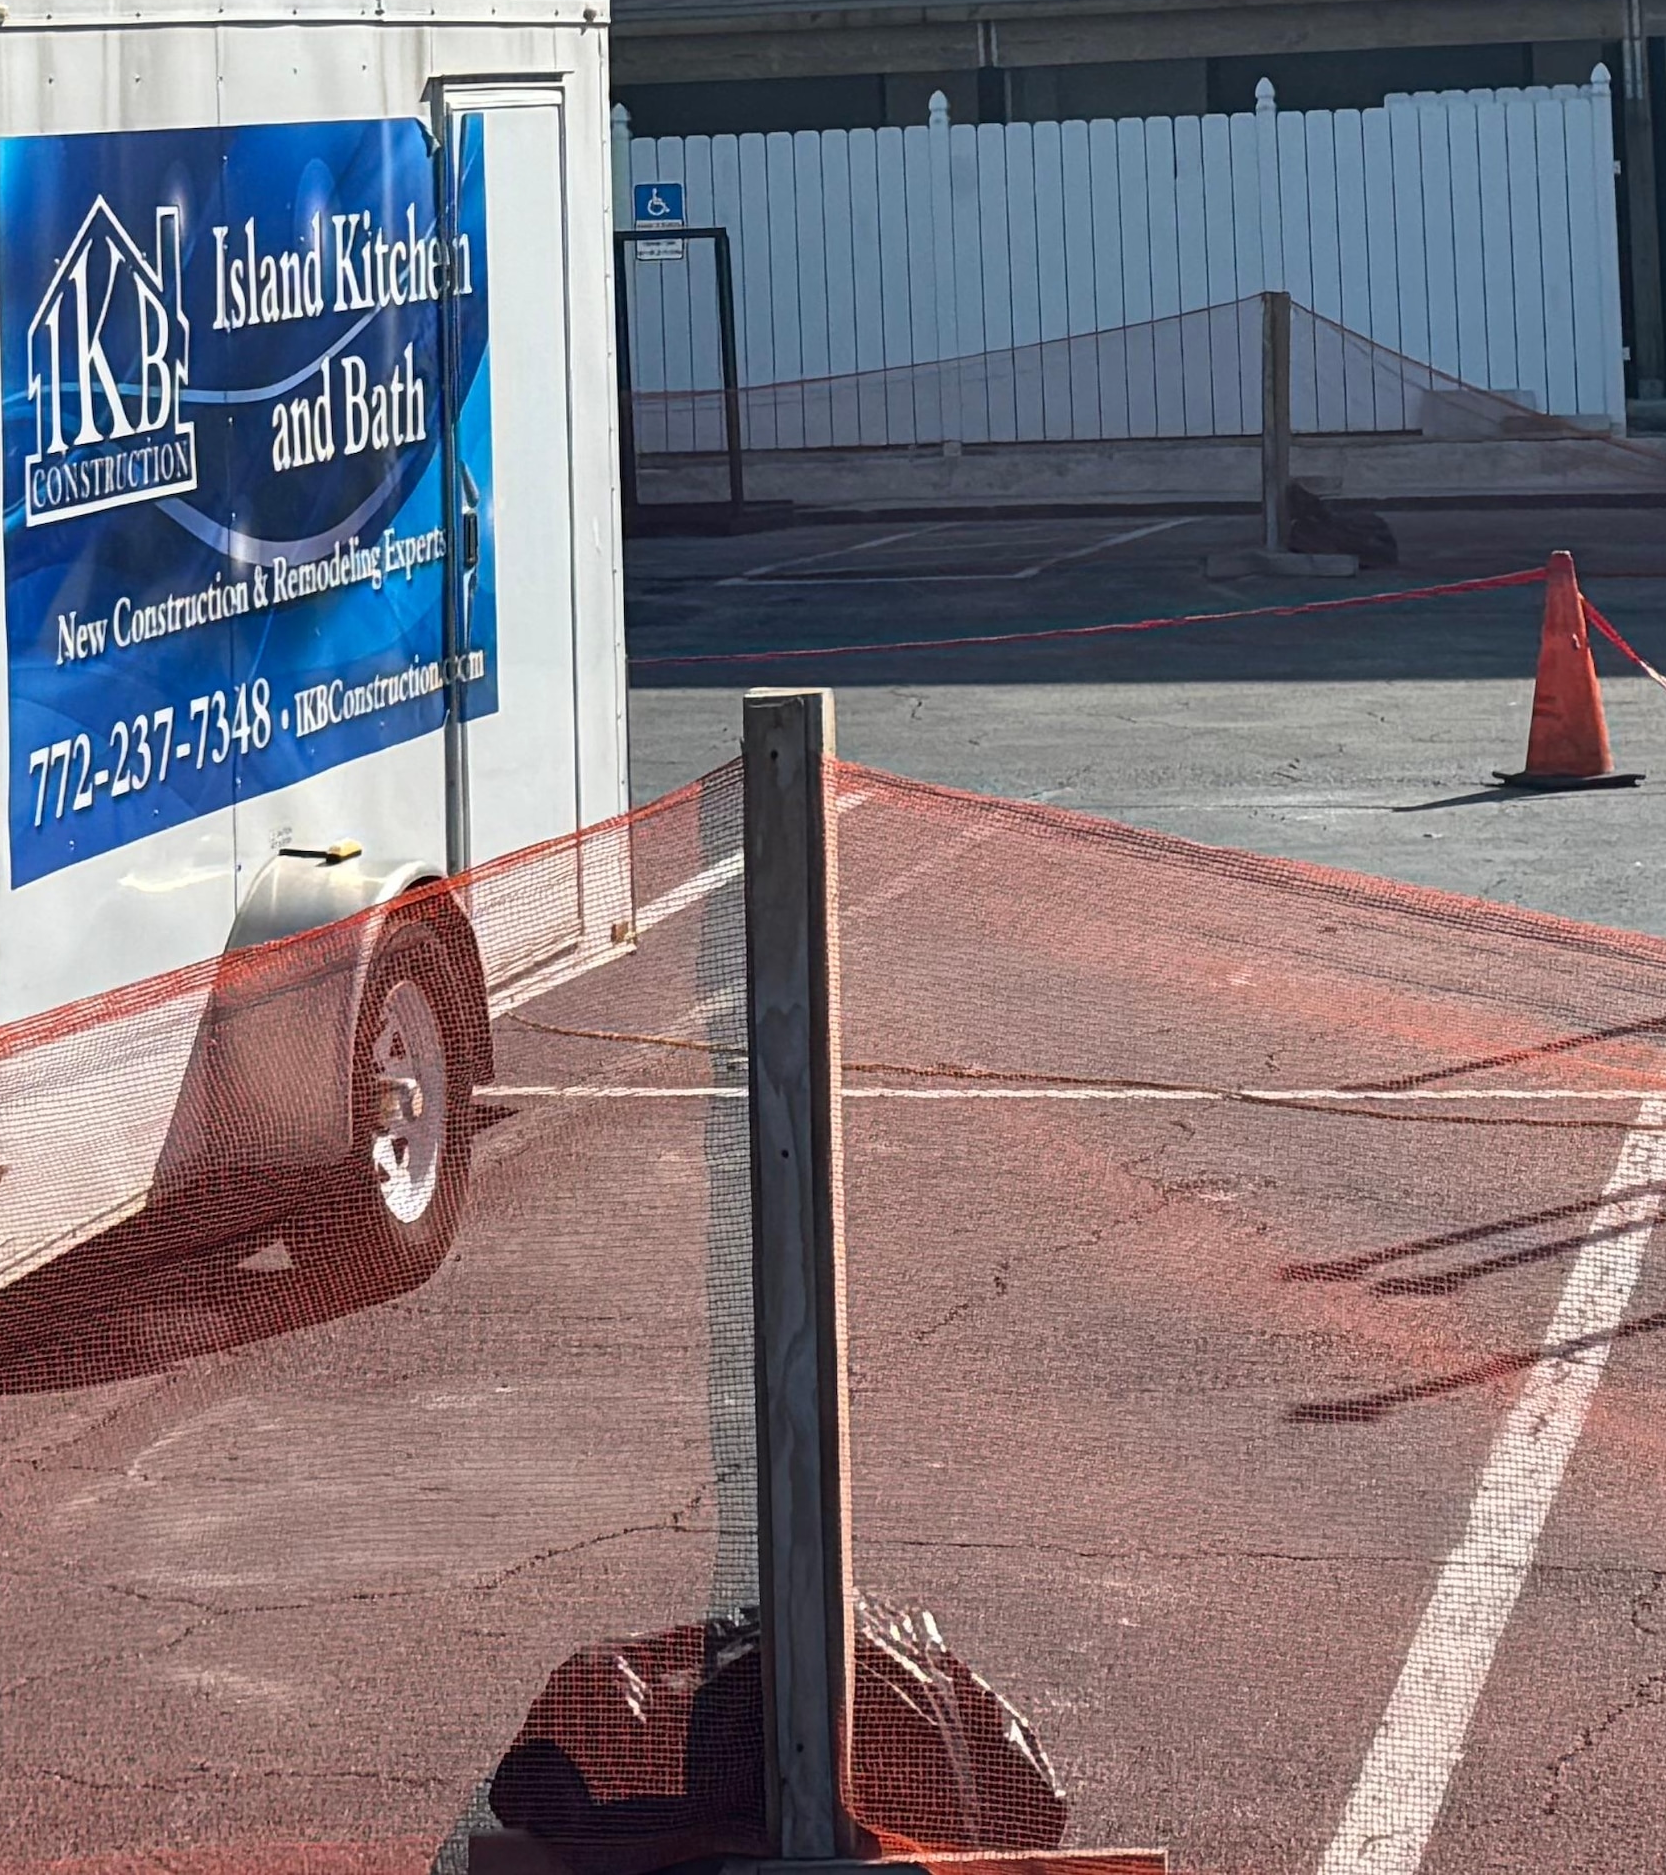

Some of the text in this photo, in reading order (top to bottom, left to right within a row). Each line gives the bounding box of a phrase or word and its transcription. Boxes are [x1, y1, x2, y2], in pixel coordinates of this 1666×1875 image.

[212, 202, 473, 331] Island Kitchen
[44, 235, 172, 455] IKB
[271, 341, 427, 473] and Bath
[31, 440, 190, 509] CONSTRUCTION
[55, 525, 447, 666] New Construction & Remodeling Experts
[28, 677, 273, 828] 772-237-7348
